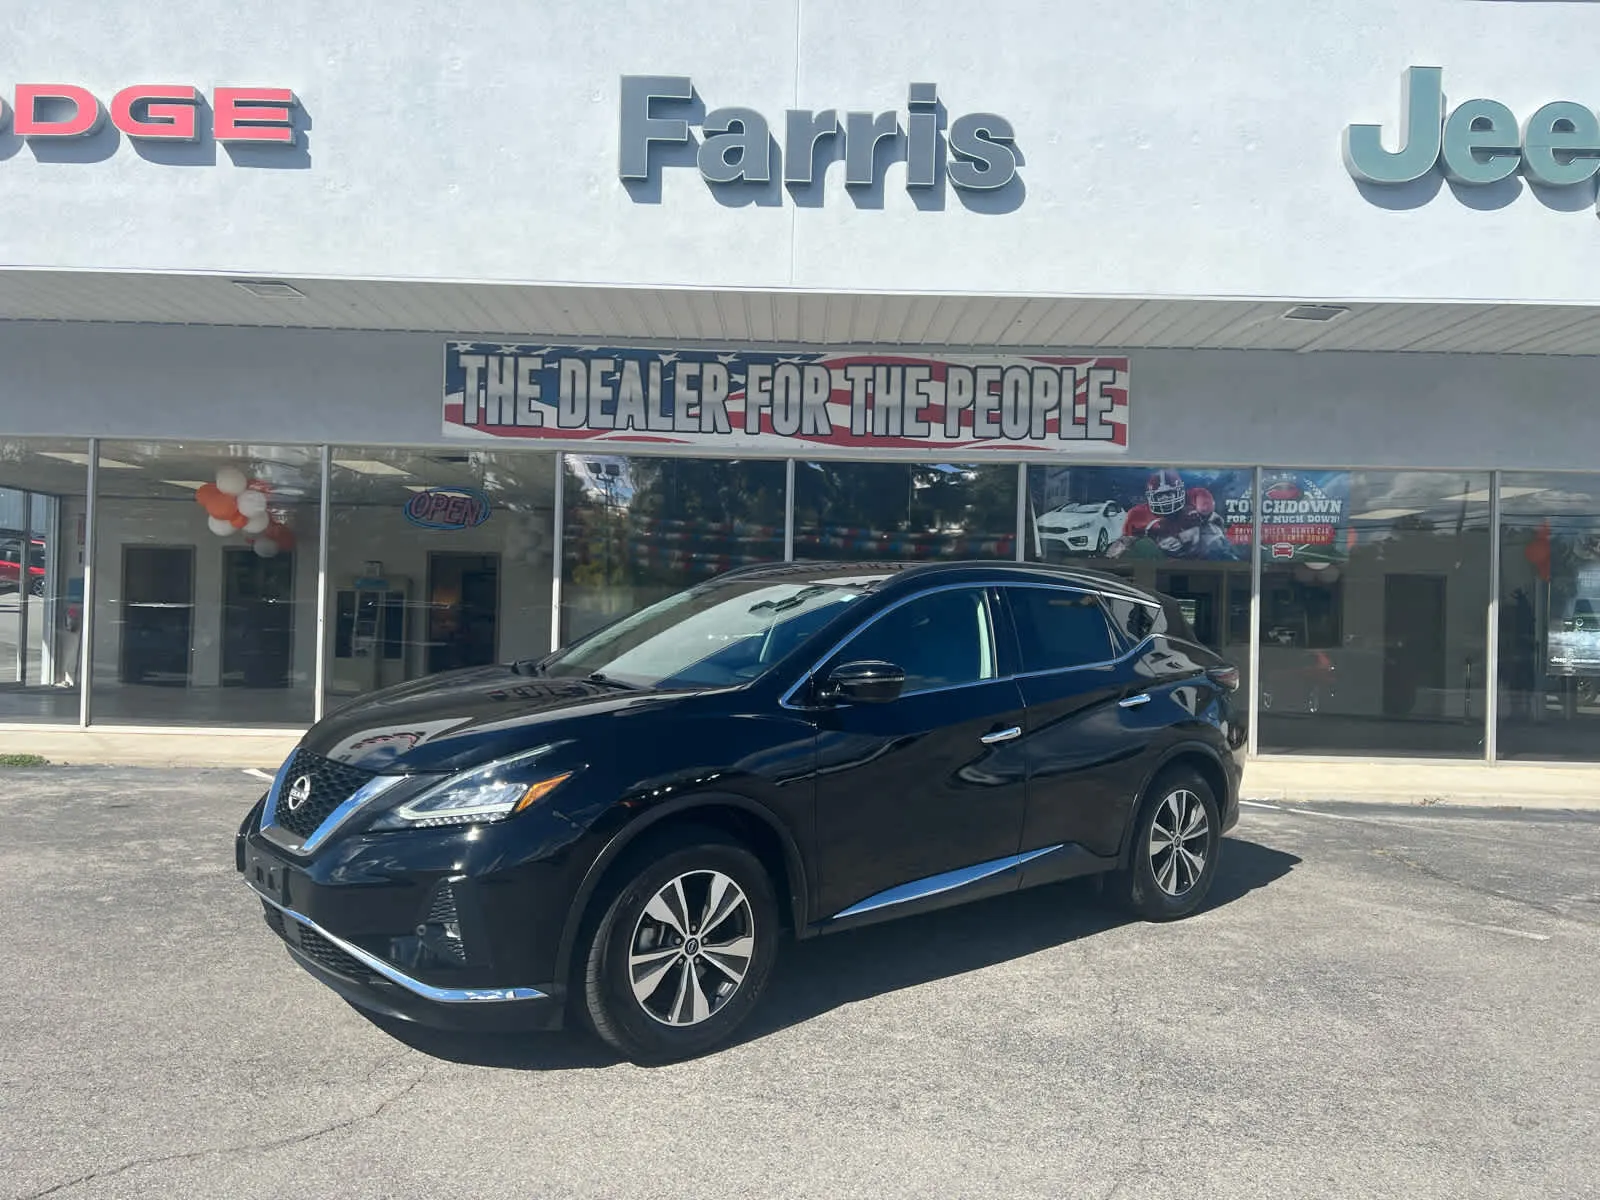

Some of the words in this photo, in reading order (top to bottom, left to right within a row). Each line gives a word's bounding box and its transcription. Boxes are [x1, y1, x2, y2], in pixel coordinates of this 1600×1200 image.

[0, 83, 297, 145] DGE
[618, 74, 1017, 190] Farris
[1342, 65, 1600, 188] Jee
[459, 354, 544, 427] THE
[557, 356, 733, 433] DEALER
[744, 361, 832, 436] FOR
[844, 364, 932, 438] THE
[944, 364, 1117, 441] PEOPLE
[410, 490, 481, 528] OPEN
[1272, 514, 1304, 524] MUCH
